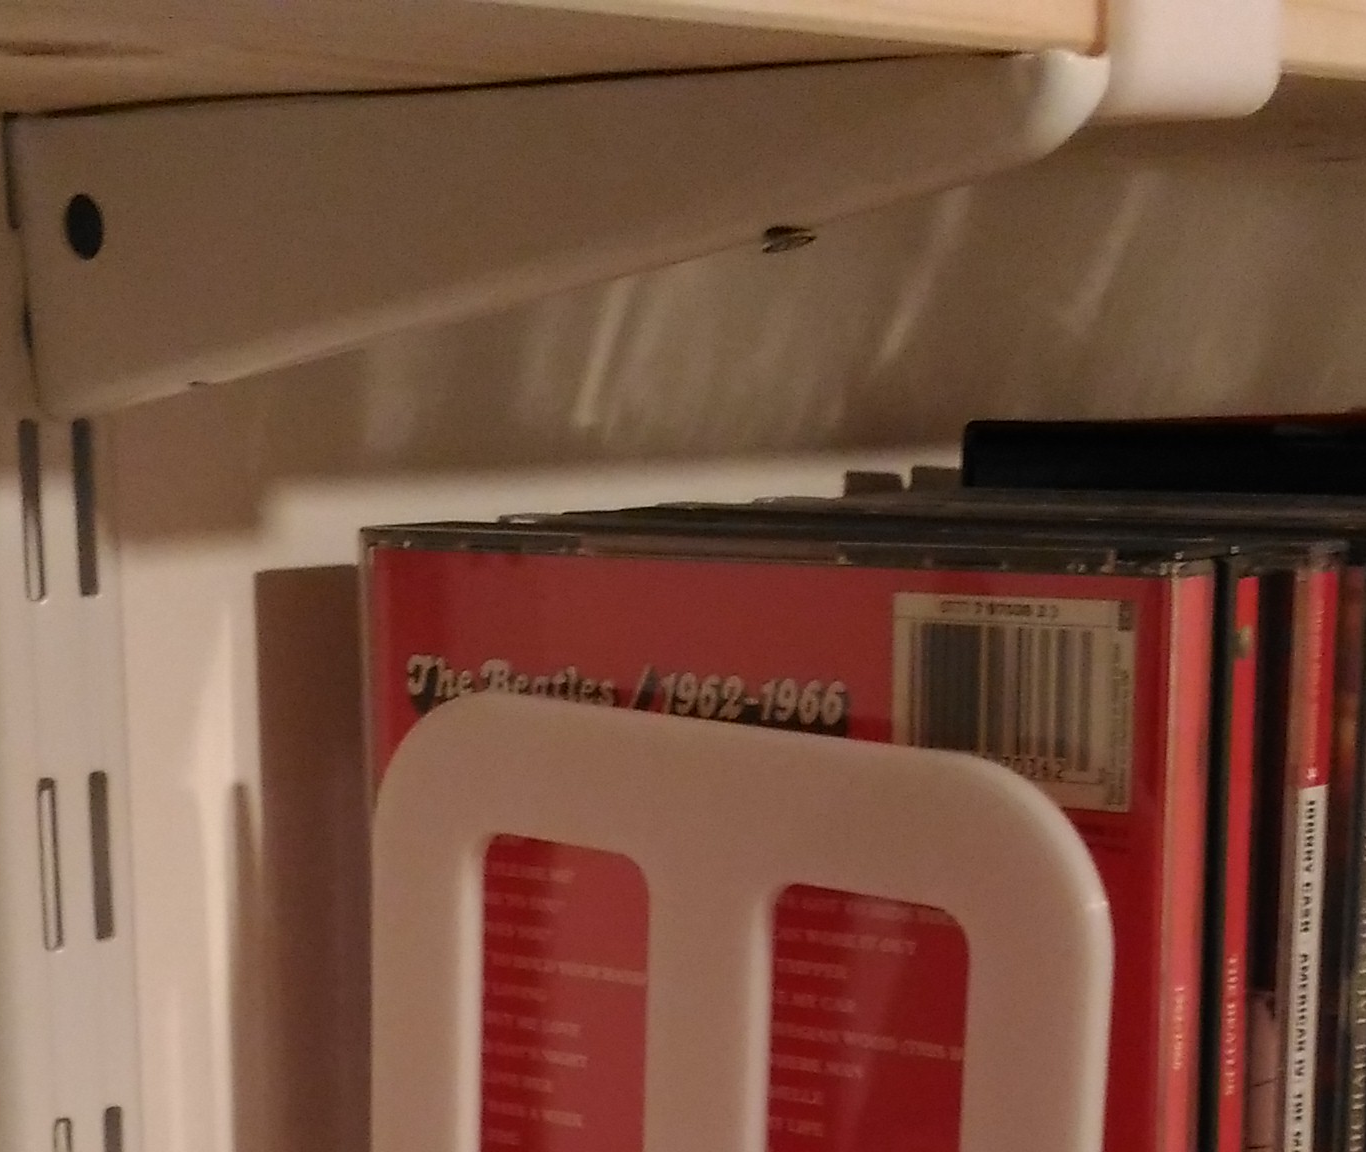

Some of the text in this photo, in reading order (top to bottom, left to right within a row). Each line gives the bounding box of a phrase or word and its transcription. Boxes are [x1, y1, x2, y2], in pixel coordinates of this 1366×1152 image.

[407, 654, 473, 699] The
[481, 659, 614, 706] Beatles
[660, 672, 848, 726] 1962-1966
[1302, 800, 1317, 873] JOHNNY
[1299, 881, 1313, 933] CASH
[1296, 953, 1310, 1051] AMERICAN
